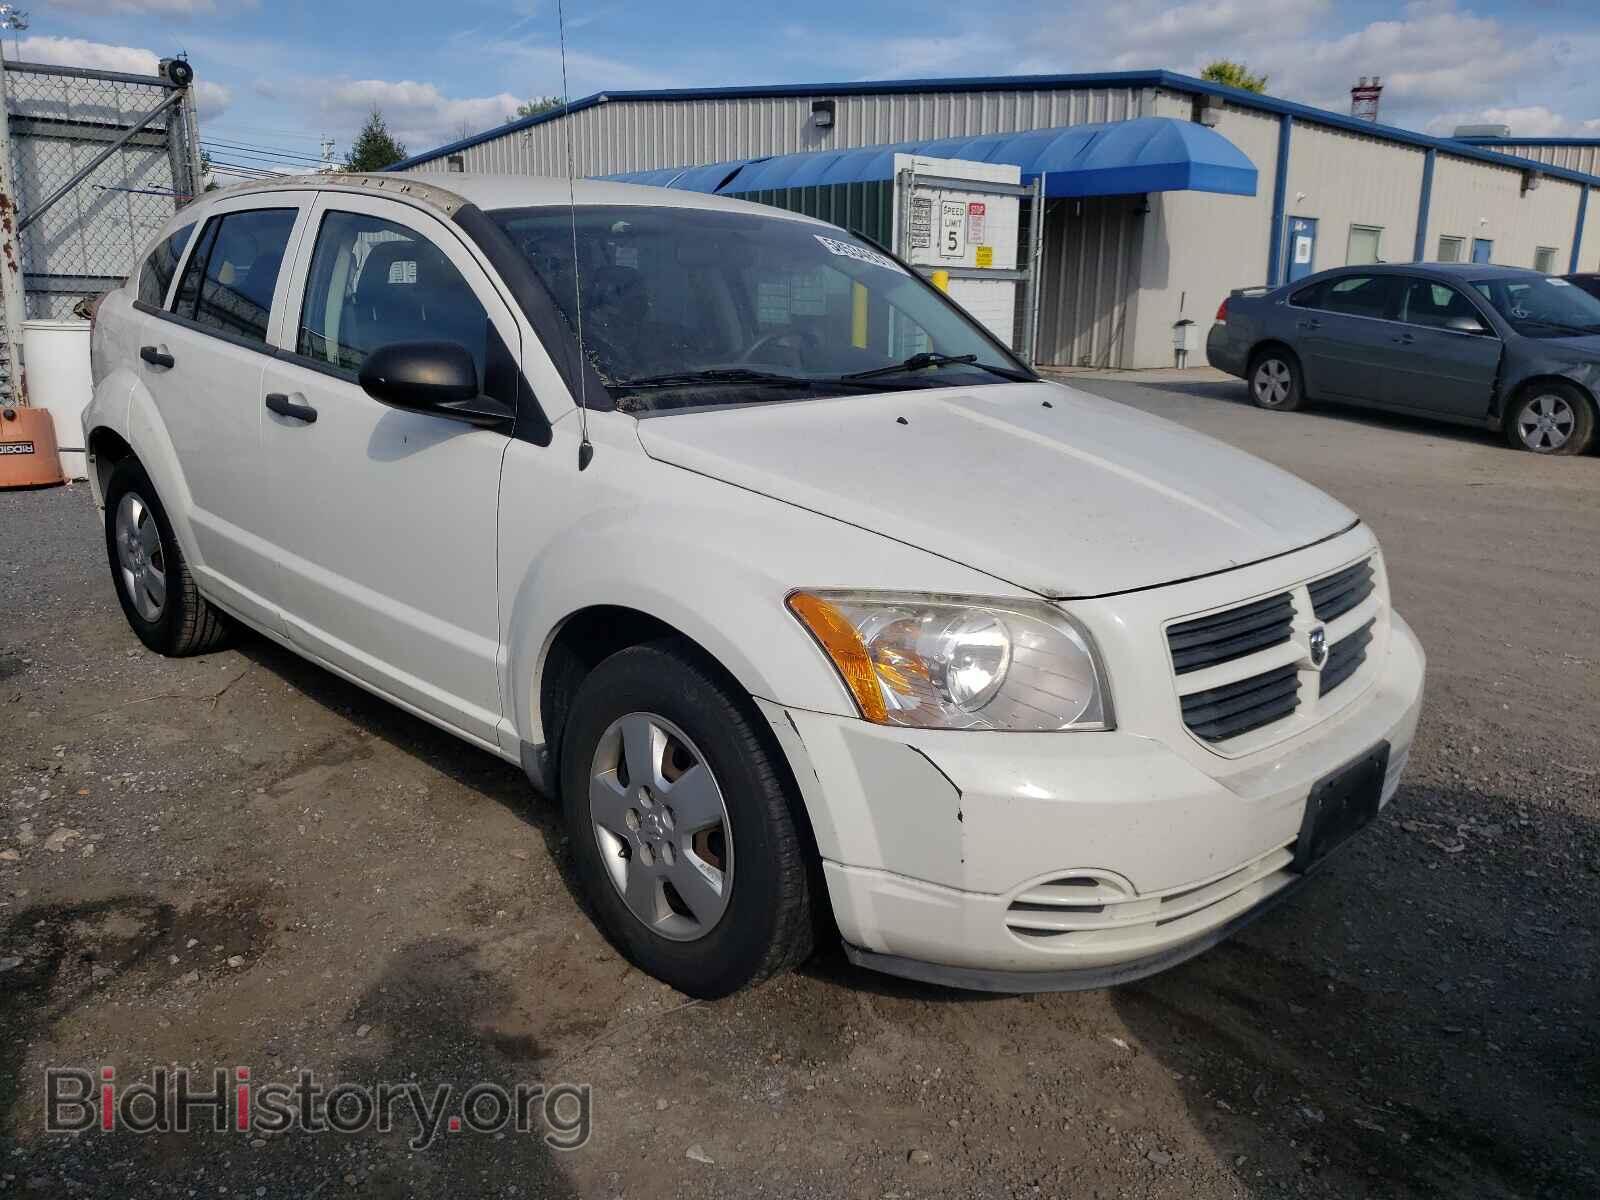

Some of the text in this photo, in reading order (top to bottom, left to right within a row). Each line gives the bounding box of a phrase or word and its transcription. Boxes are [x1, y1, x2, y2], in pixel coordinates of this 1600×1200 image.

[943, 205, 964, 216] SPEED
[970, 205, 985, 215] STOP
[944, 218, 962, 228] LIMIT
[947, 231, 958, 251] 5
